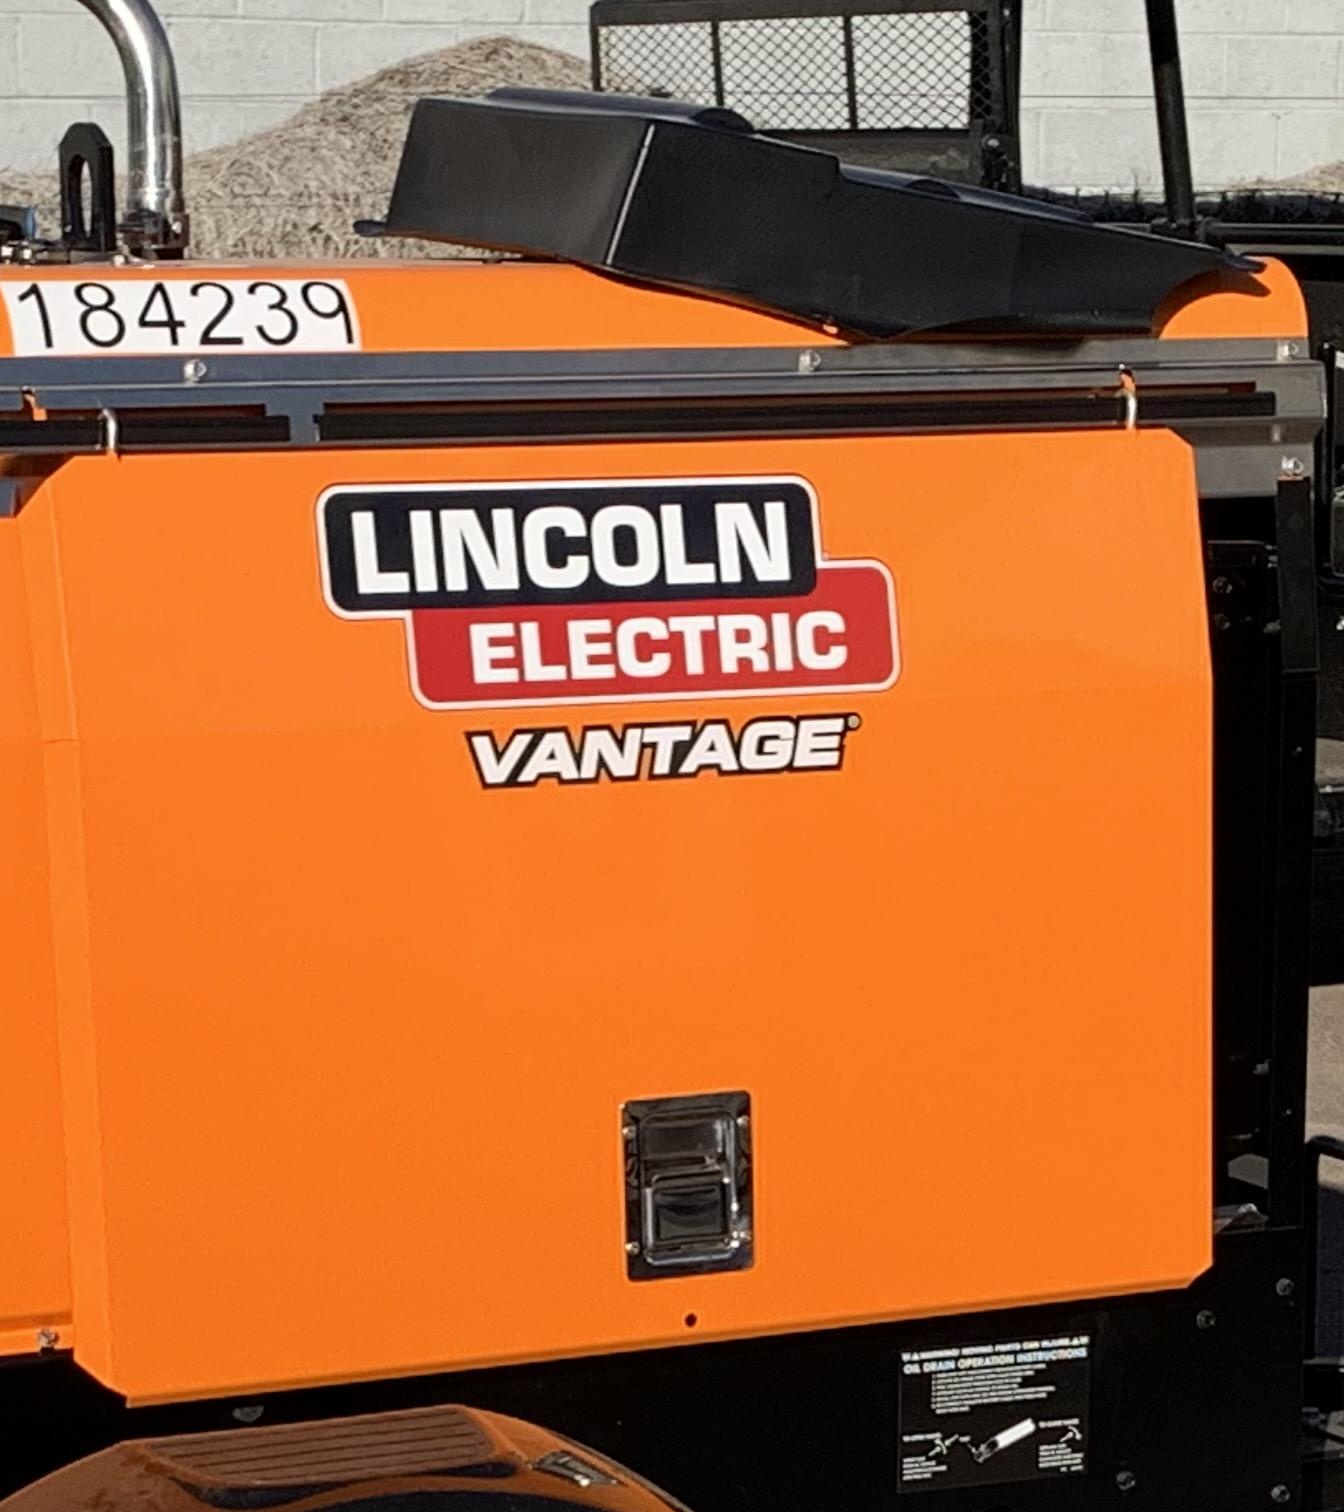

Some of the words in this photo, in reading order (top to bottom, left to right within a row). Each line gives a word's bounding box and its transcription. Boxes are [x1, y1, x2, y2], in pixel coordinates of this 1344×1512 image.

[17, 281, 355, 348] 184239
[350, 501, 792, 595] LINCOLN
[468, 610, 849, 685] ELECTRIC
[468, 715, 848, 788] VANTAGE
